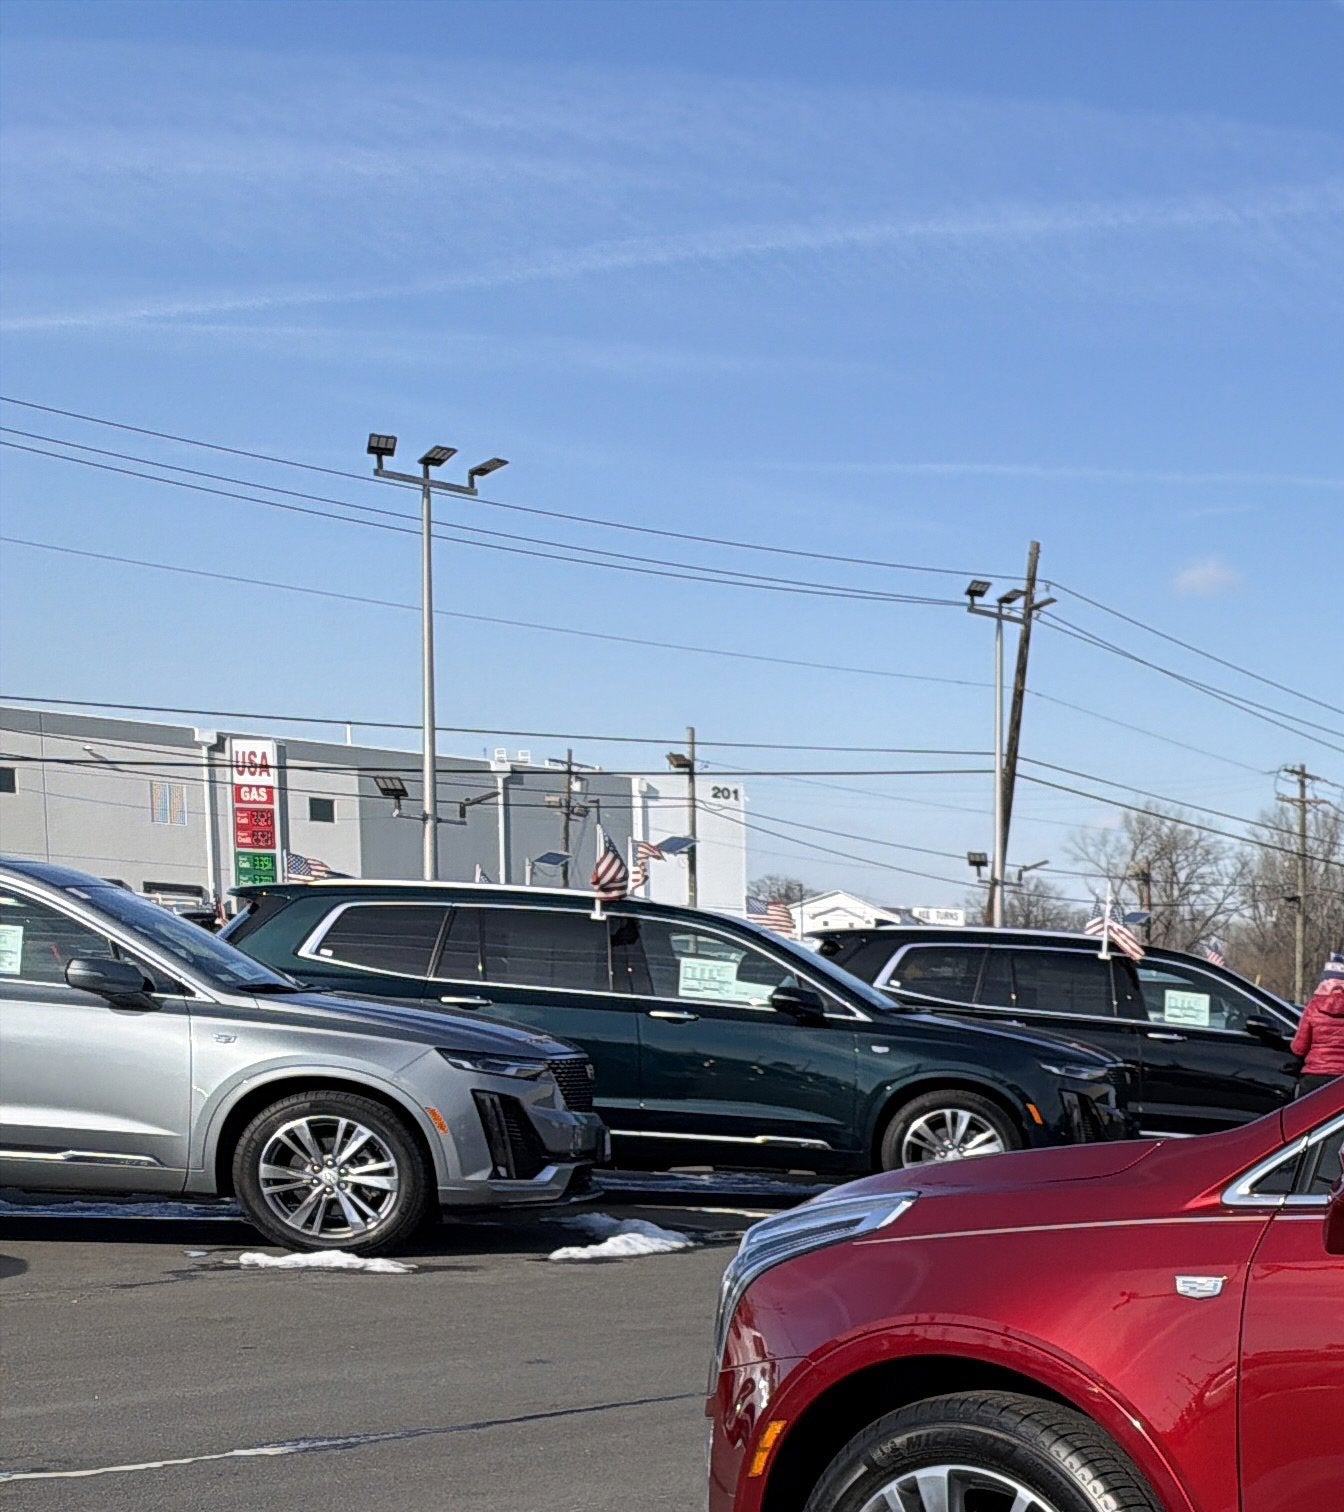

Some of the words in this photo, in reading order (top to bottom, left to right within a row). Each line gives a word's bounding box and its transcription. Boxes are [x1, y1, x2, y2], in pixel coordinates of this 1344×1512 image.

[235, 750, 271, 777] USA
[240, 786, 268, 801] GAS
[711, 785, 739, 801] 201
